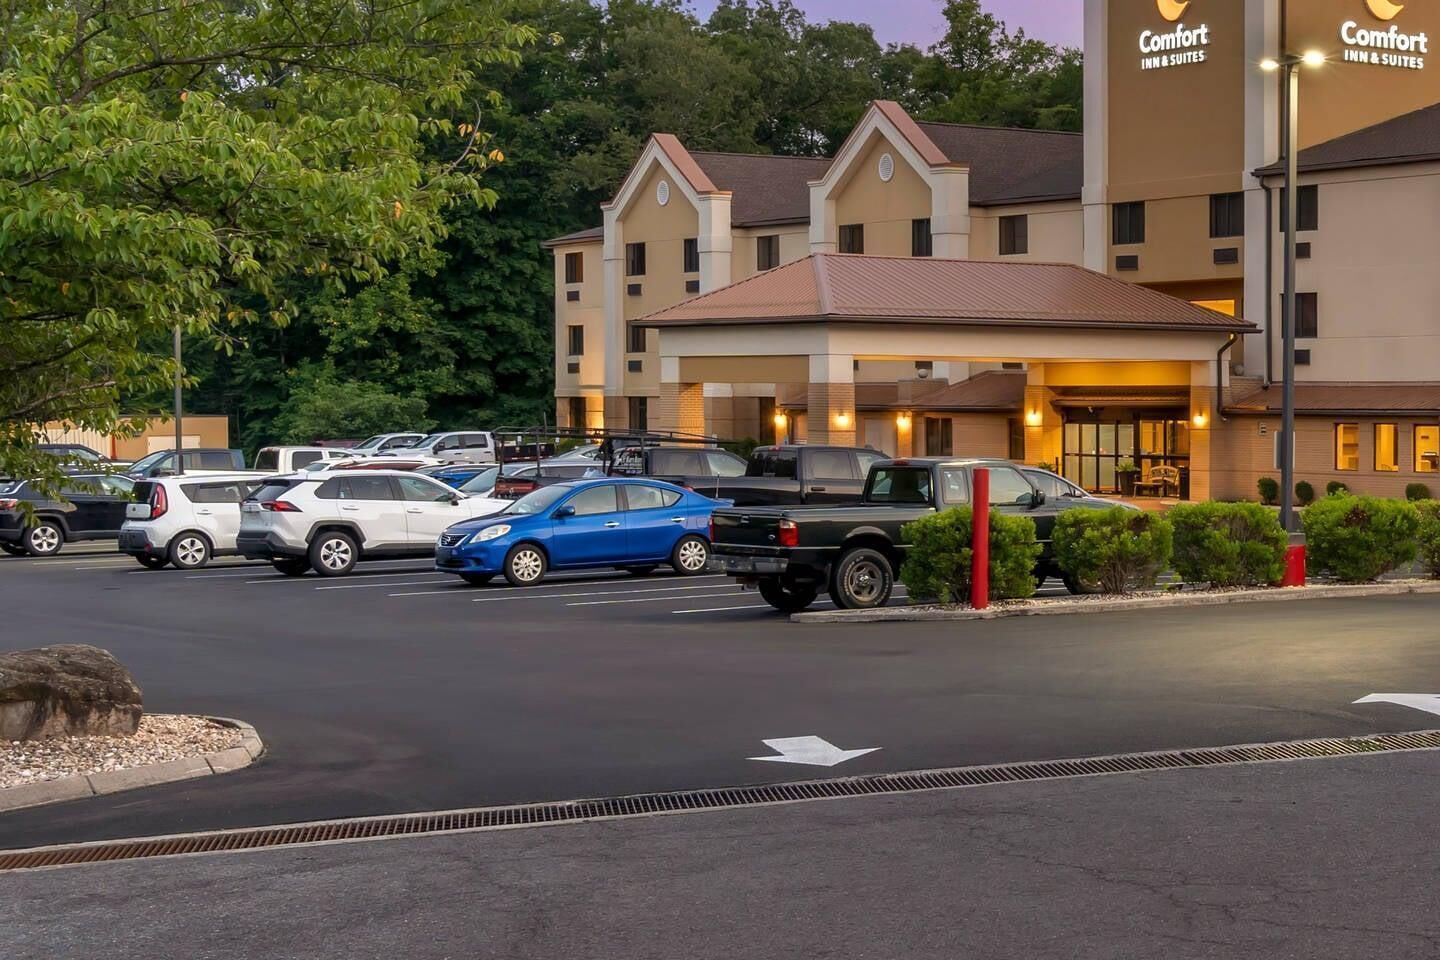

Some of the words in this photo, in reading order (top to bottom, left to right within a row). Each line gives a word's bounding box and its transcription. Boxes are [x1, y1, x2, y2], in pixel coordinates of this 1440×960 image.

[1139, 23, 1208, 53] Comfort
[1341, 20, 1428, 53] Comfort
[1141, 57, 1160, 70] INN
[1161, 55, 1168, 67] &
[1170, 50, 1204, 66] SUITES
[1344, 49, 1368, 63] INN
[1370, 52, 1379, 64] &
[1382, 53, 1424, 69] SUITES
